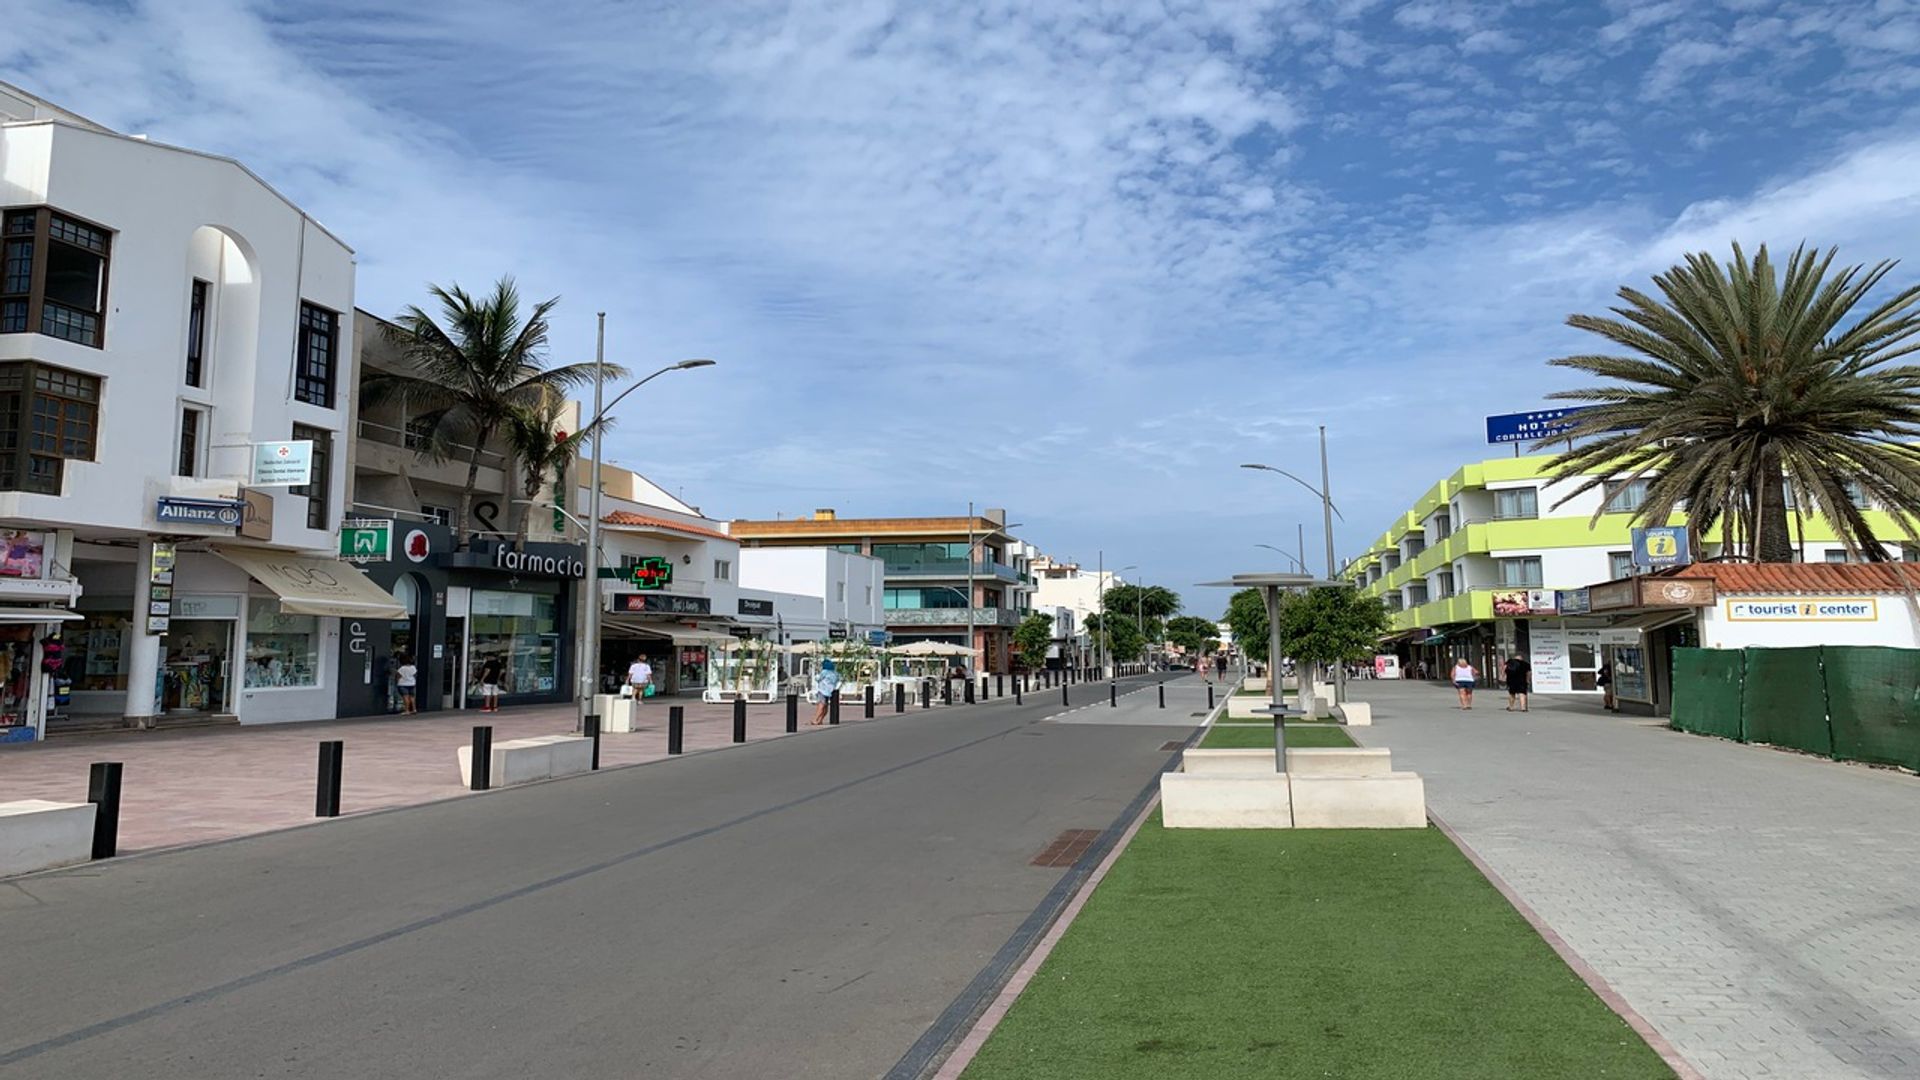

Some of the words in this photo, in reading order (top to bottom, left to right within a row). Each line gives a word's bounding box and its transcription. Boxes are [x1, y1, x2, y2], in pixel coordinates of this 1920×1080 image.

[1495, 429, 1559, 441] CORRALEJO
[161, 506, 216, 519] Allianz
[1646, 529, 1674, 537] tourist
[497, 544, 584, 577] farmacia
[1748, 604, 1797, 614] tourist
[1819, 604, 1867, 614] center
